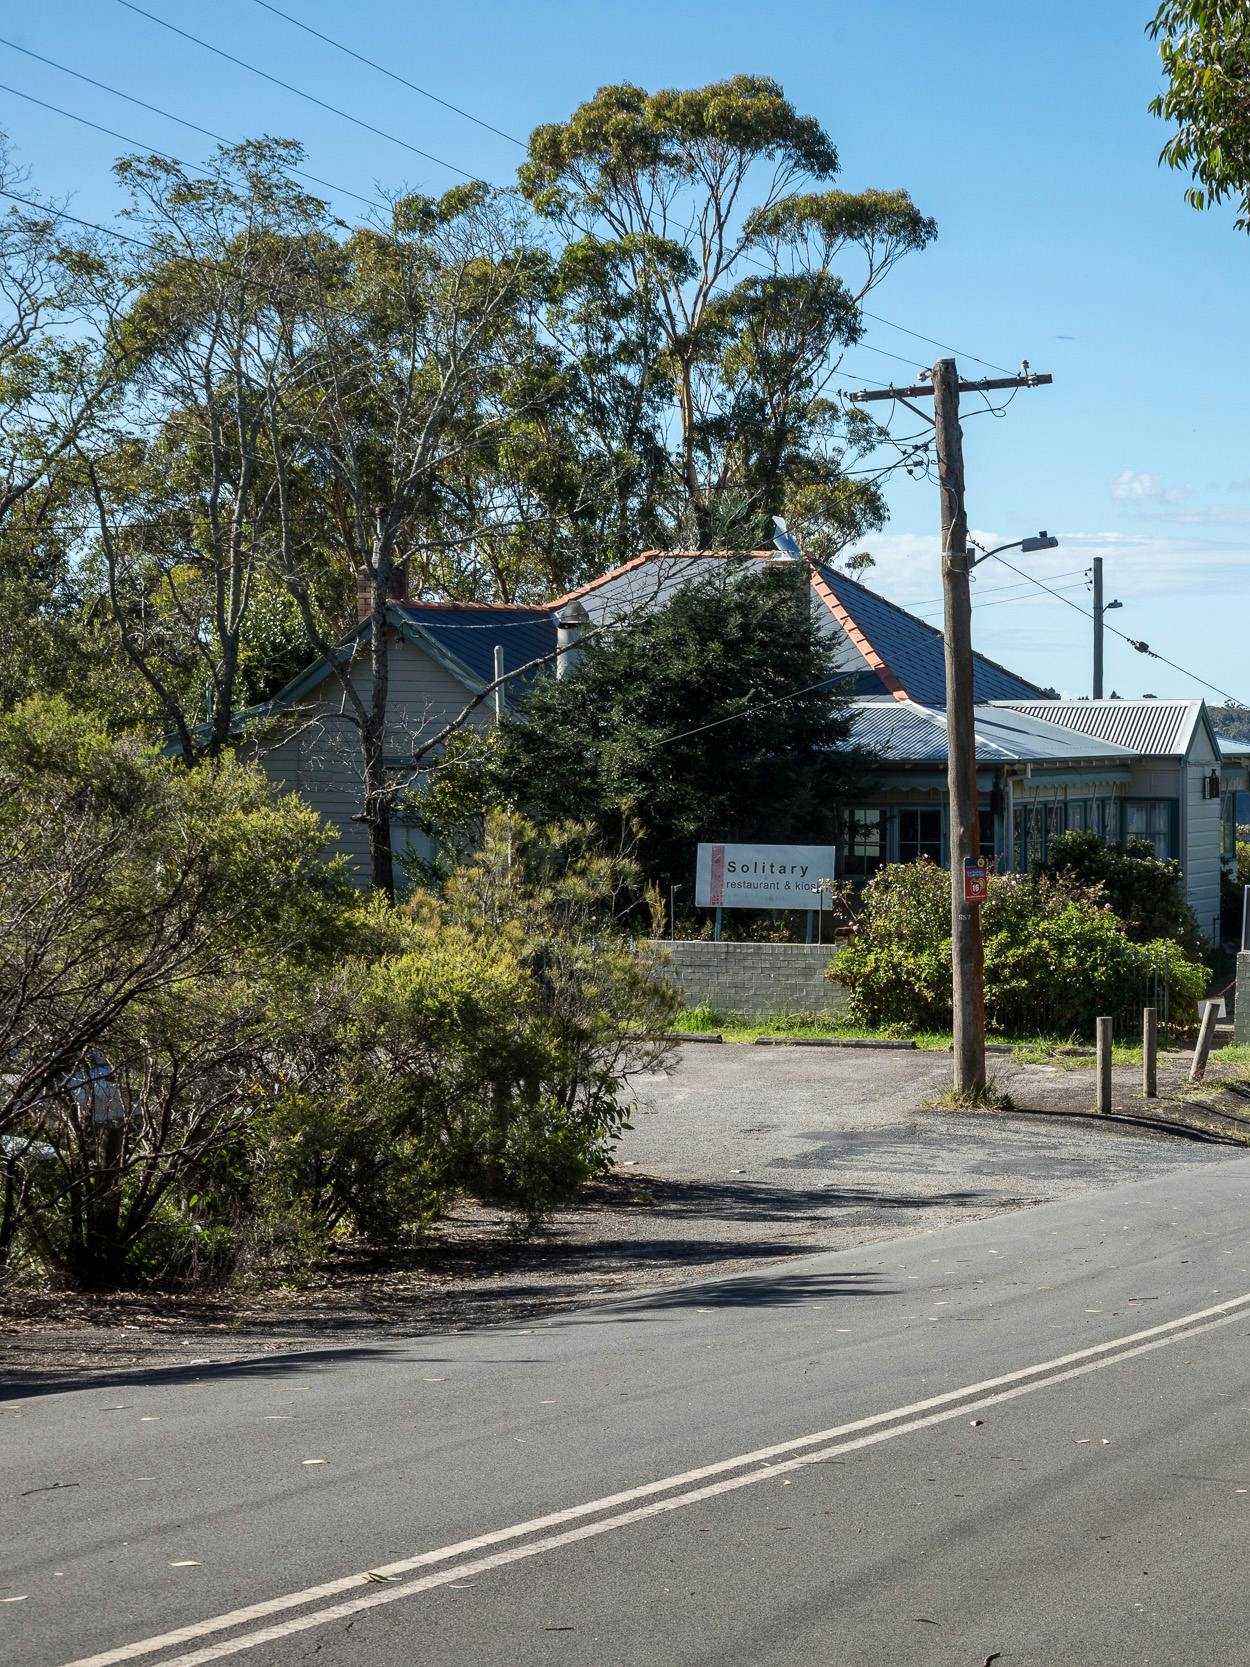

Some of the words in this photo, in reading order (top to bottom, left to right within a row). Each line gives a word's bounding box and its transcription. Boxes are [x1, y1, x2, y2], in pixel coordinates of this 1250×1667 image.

[727, 861, 809, 877] Solitary
[726, 880, 780, 890] restaurant
[784, 881, 791, 890] &
